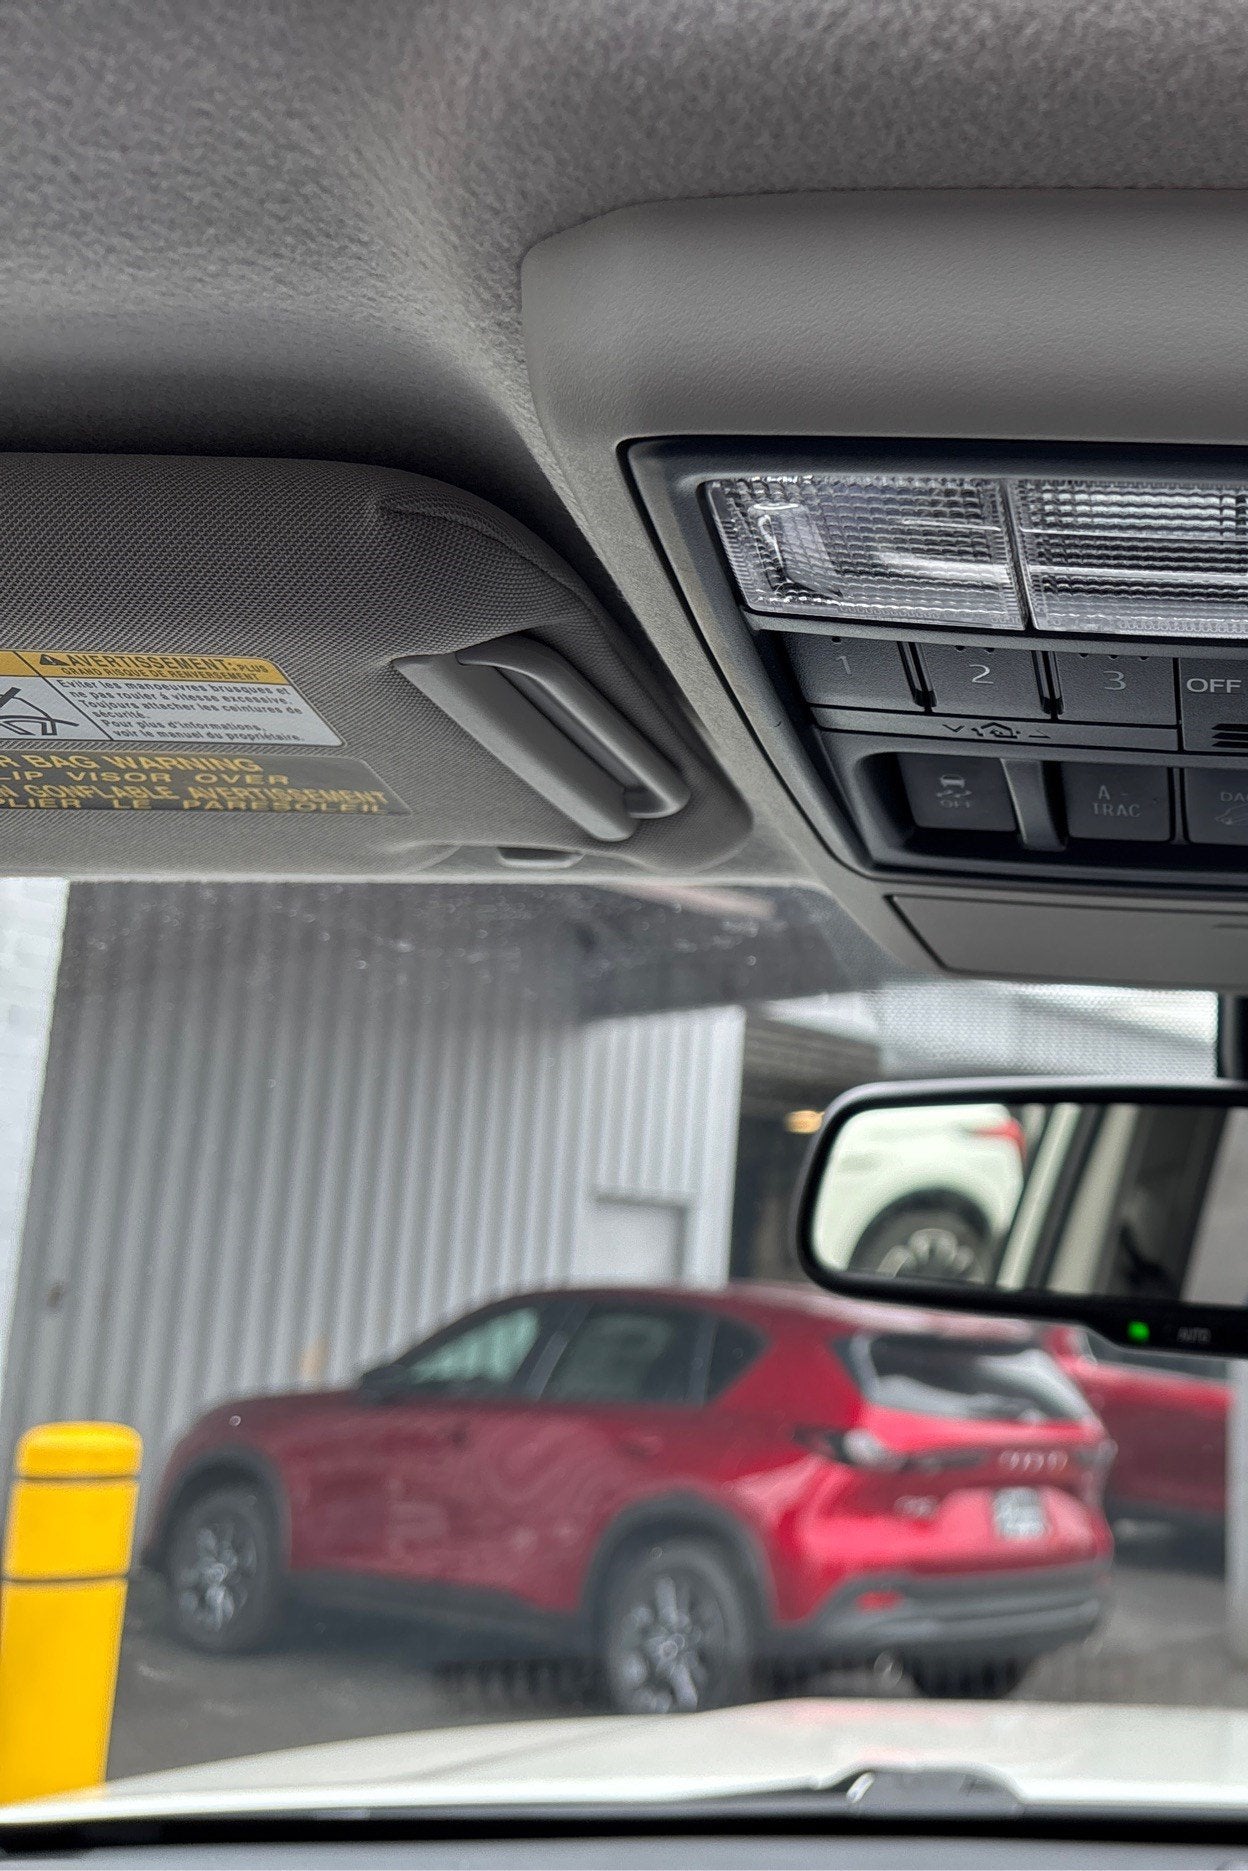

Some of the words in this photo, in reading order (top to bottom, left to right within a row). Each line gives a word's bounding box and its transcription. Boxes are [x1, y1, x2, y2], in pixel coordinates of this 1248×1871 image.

[60, 667, 103, 676] GRAND
[103, 668, 149, 677] RISQUE
[149, 670, 167, 678] DE
[167, 670, 260, 680] RENVERSEMENT
[236, 664, 269, 674] PLUS
[834, 655, 853, 676] 1
[968, 663, 995, 685] 2
[1103, 670, 1128, 692] 3
[98, 680, 122, 690] les
[123, 682, 207, 692] manoeuvres
[208, 683, 274, 695] brusques
[275, 686, 291, 696] et
[1186, 678, 1243, 694] OFF
[69, 691, 88, 699] ne
[88, 692, 116, 701] pas
[115, 691, 158, 700] rouler
[171, 692, 220, 702] vitesse
[78, 699, 140, 710] Toujours
[140, 701, 196, 711] attacher
[196, 702, 220, 712] les
[221, 703, 283, 714] ceintures
[285, 706, 303, 715] de
[100, 719, 134, 728] Pour
[135, 720, 166, 730] plus
[112, 728, 138, 738] voir
[138, 729, 155, 738] le
[156, 730, 203, 740] manuel
[206, 731, 224, 740] du
[21, 754, 101, 770] BAG
[101, 756, 264, 772] WARNING
[0, 771, 44, 781] IP
[65, 771, 172, 783] VISOR
[194, 773, 289, 785] OVER
[23, 784, 181, 800] GONFLABLE
[187, 786, 389, 805] AVERTISSEMENT
[112, 799, 152, 810] LE
[183, 800, 386, 815] PARESOLEIL
[1092, 802, 1141, 817] TRAC
